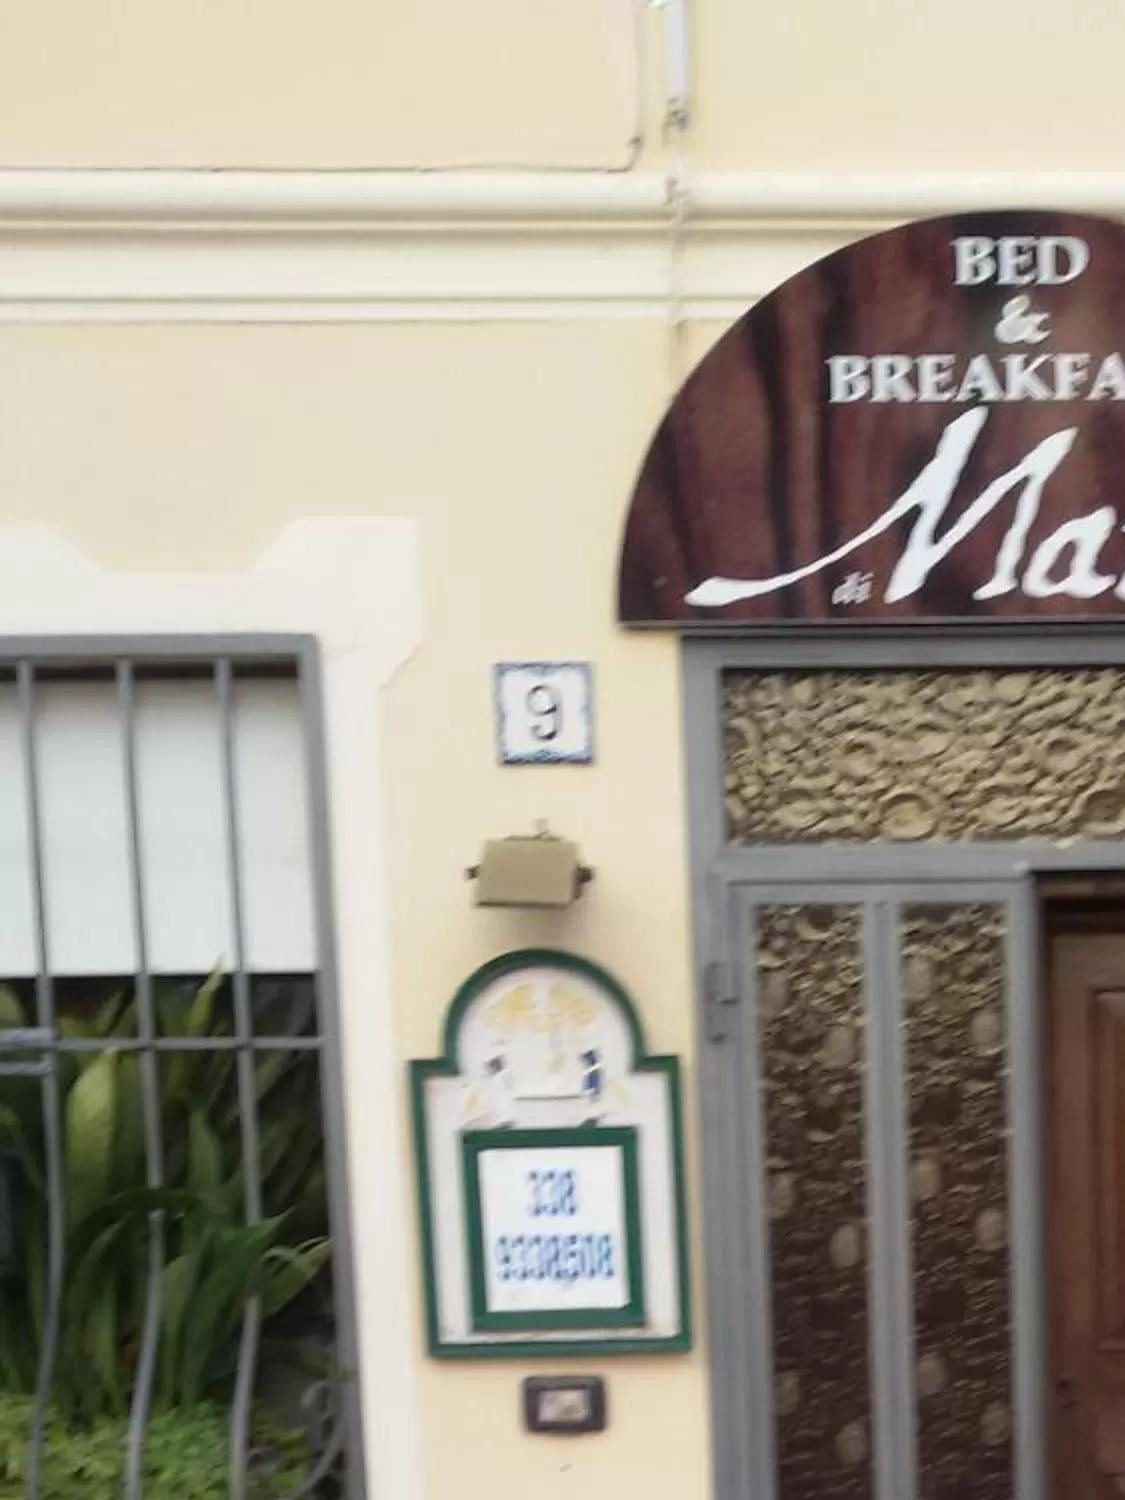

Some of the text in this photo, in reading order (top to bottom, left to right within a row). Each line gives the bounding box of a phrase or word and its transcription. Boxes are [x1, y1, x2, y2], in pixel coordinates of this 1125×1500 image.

[950, 235, 1091, 288] BED
[994, 294, 1052, 345] &
[524, 683, 564, 743] 9
